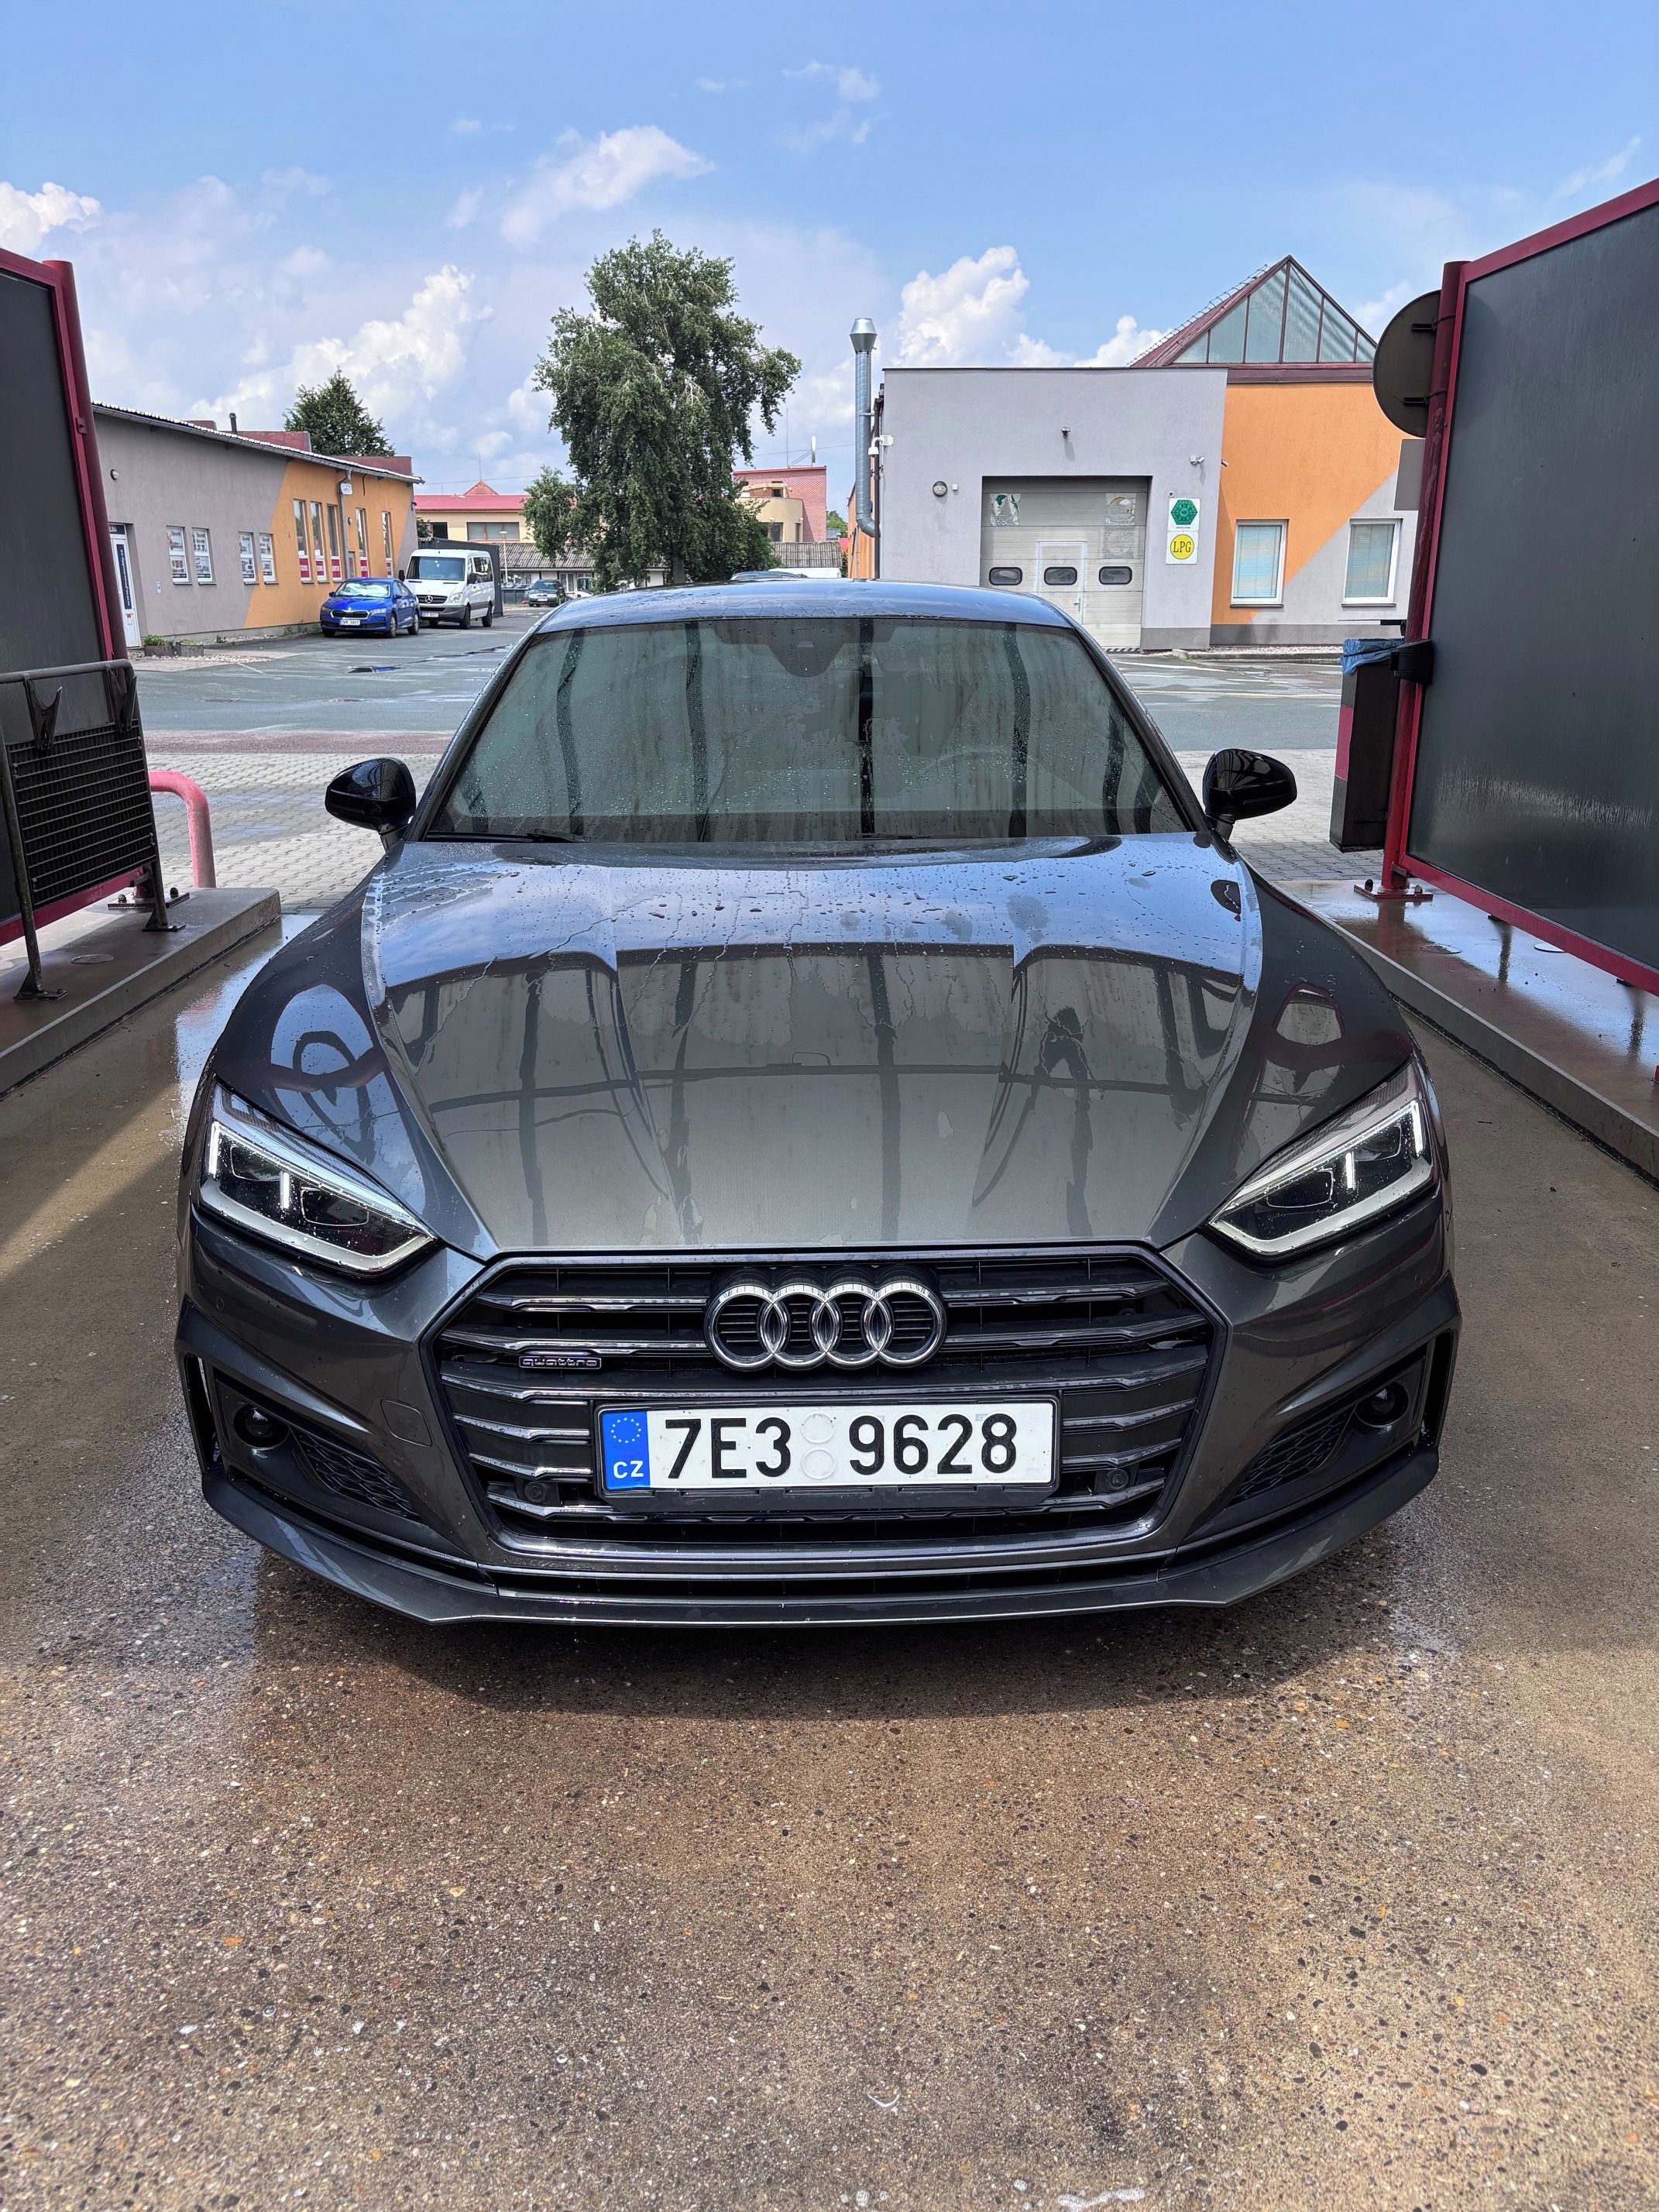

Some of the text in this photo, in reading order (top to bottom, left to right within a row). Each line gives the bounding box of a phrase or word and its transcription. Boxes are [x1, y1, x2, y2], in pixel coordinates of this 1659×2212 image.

[1173, 541, 1191, 553] LPG
[522, 1358, 597, 1367] quattro
[665, 1413, 1018, 1479] 7E3 9628
[613, 1460, 644, 1479] CZ
